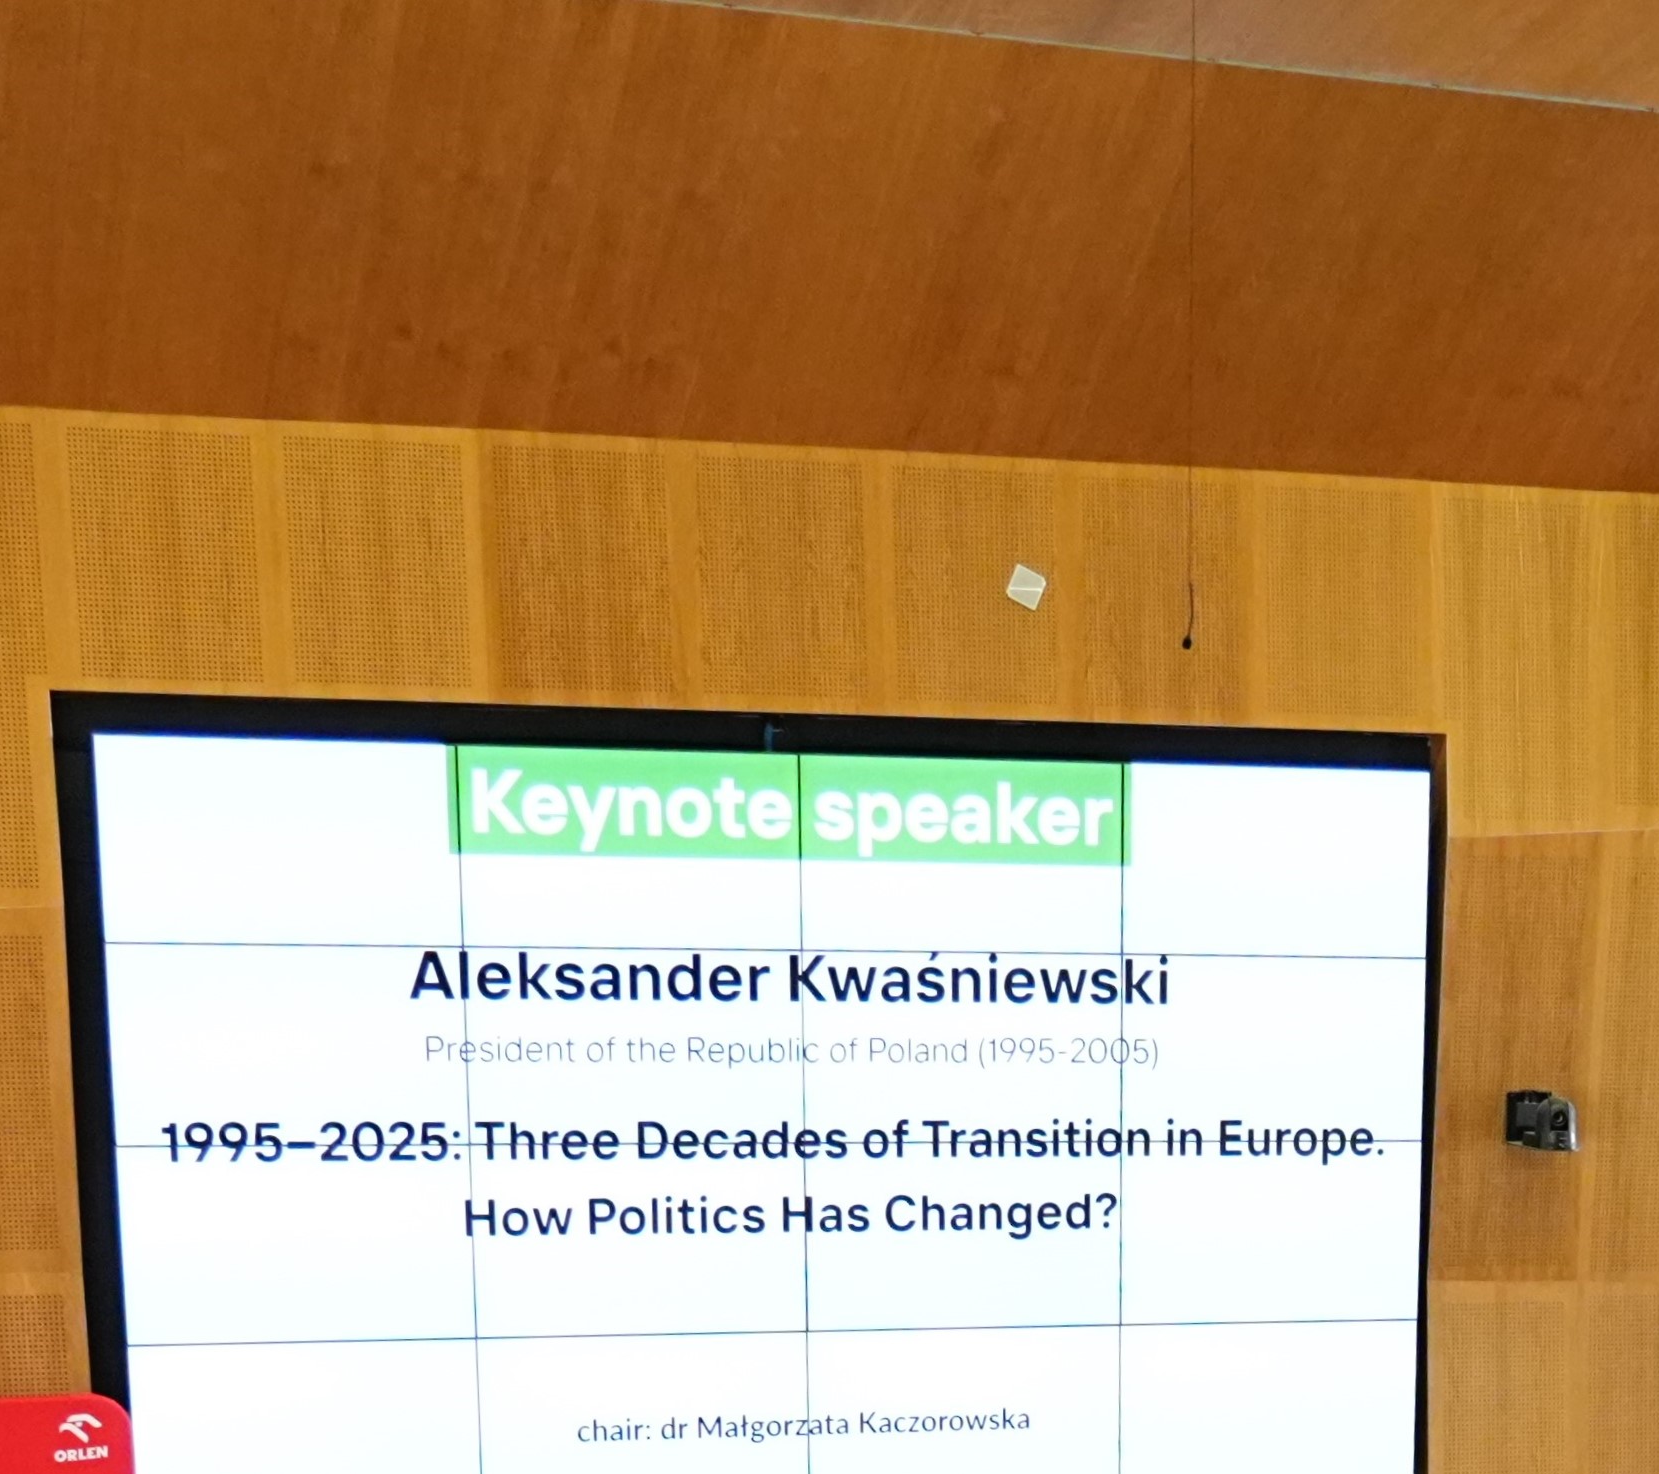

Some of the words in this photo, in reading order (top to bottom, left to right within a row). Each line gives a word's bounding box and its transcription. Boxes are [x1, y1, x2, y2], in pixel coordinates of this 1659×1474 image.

[470, 767, 792, 853] Keynote
[814, 782, 1114, 858] speaker
[409, 949, 769, 1003] Aleksander
[788, 951, 1170, 1007] Kwaśniewski
[425, 1036, 575, 1065] President
[586, 1036, 616, 1064] of
[627, 1036, 676, 1064] the
[687, 1037, 819, 1070] Republic
[830, 1037, 860, 1065] of
[869, 1037, 968, 1065] Poland
[978, 1036, 1159, 1071] (1995-2005)
[474, 1120, 620, 1160] Three
[637, 1120, 848, 1160] Decades
[862, 1120, 909, 1158] of
[922, 1118, 1150, 1158] Transition
[1166, 1118, 1203, 1157] in
[1219, 1119, 1385, 1166] Europe.
[464, 1198, 573, 1237] How
[589, 1195, 765, 1235] Politics
[782, 1195, 870, 1233] Has
[885, 1192, 1118, 1240] Changed?
[577, 1417, 651, 1443] chair:
[661, 1416, 687, 1441] dr
[697, 1414, 849, 1444] Małgorzata
[860, 1407, 1030, 1435] Kaczorowska
[53, 1445, 109, 1462] ORLEN
